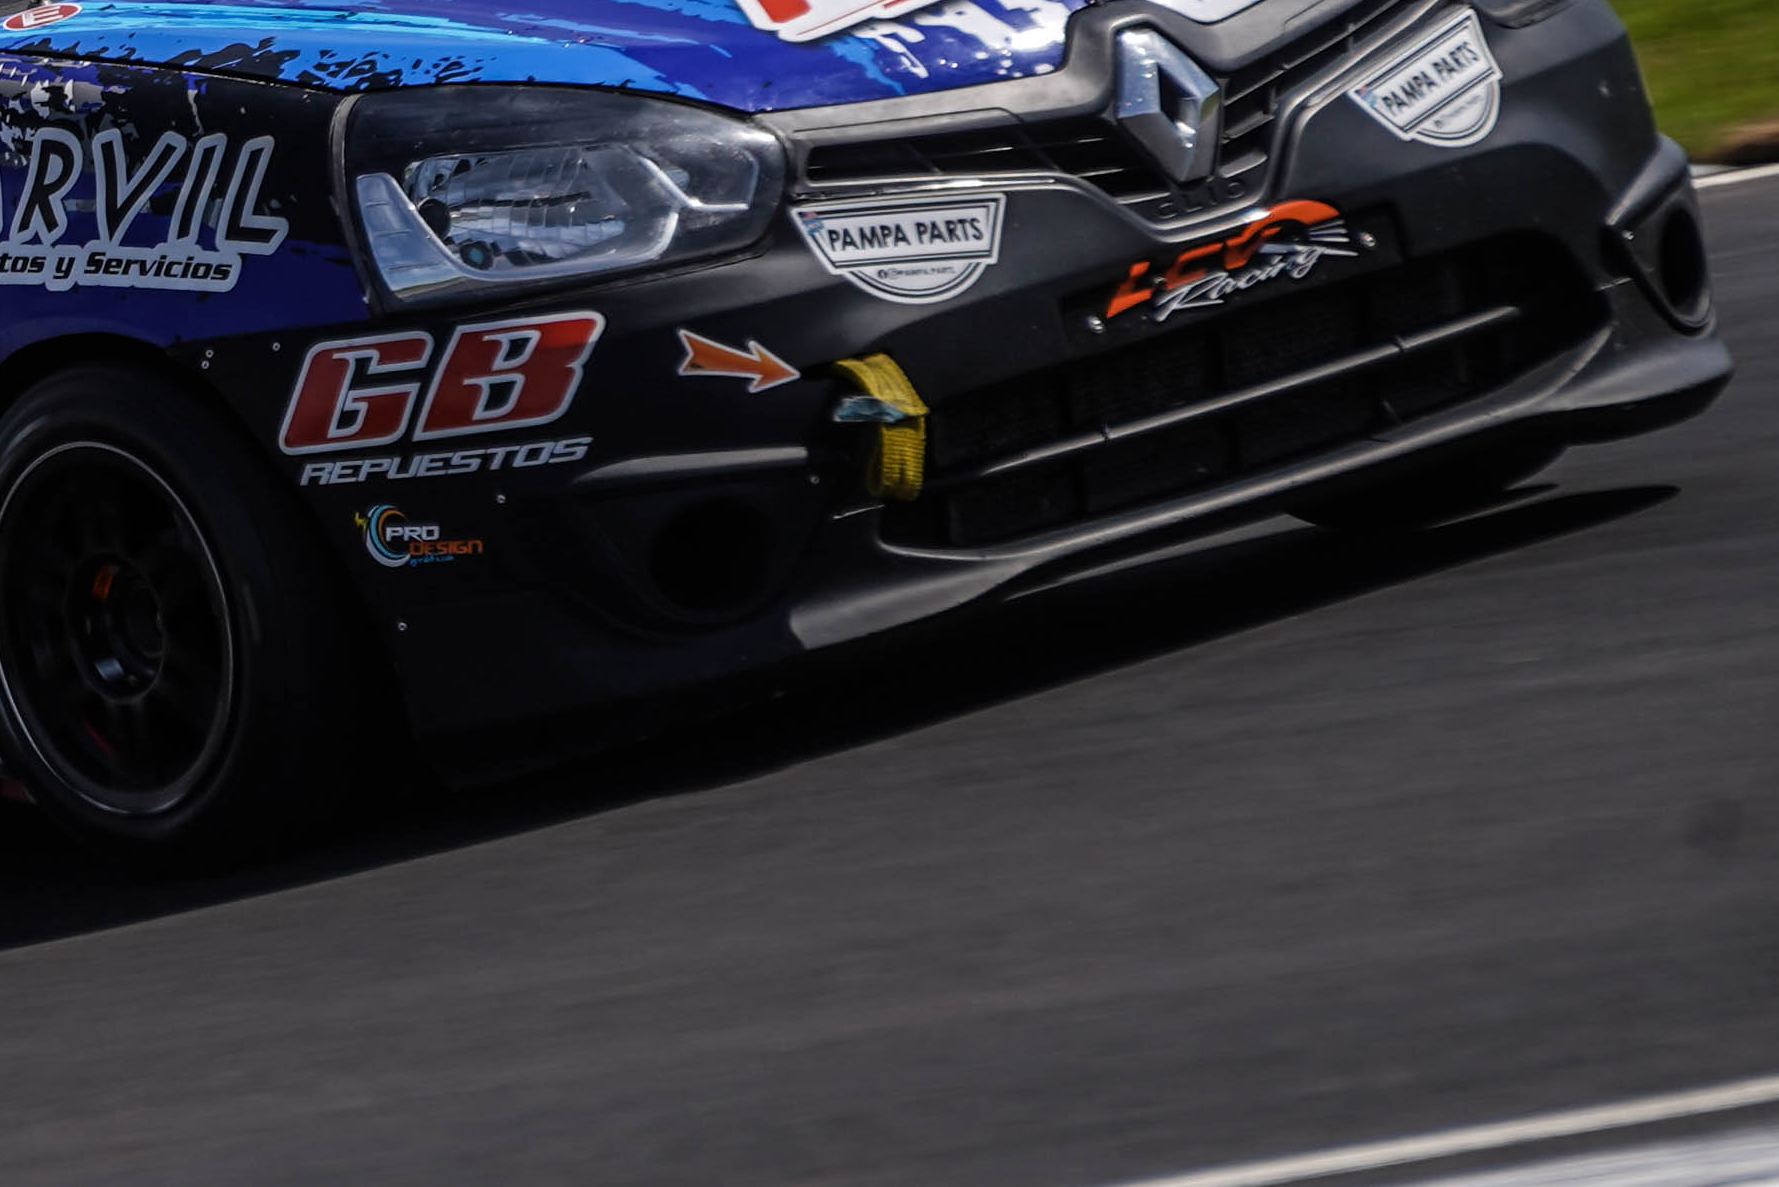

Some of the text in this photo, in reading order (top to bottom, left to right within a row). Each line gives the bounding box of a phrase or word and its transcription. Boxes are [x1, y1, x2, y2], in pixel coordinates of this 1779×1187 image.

[1381, 70, 1438, 116] PAMPA
[1432, 41, 1480, 82] PARTS
[827, 217, 984, 252] PAMPA PARTS
[53, 254, 75, 280] y
[84, 251, 233, 281] Servicios
[1154, 243, 1359, 322] Racing
[280, 311, 606, 455] GB
[299, 437, 593, 487] REPUESTOS
[385, 525, 440, 542] PRO
